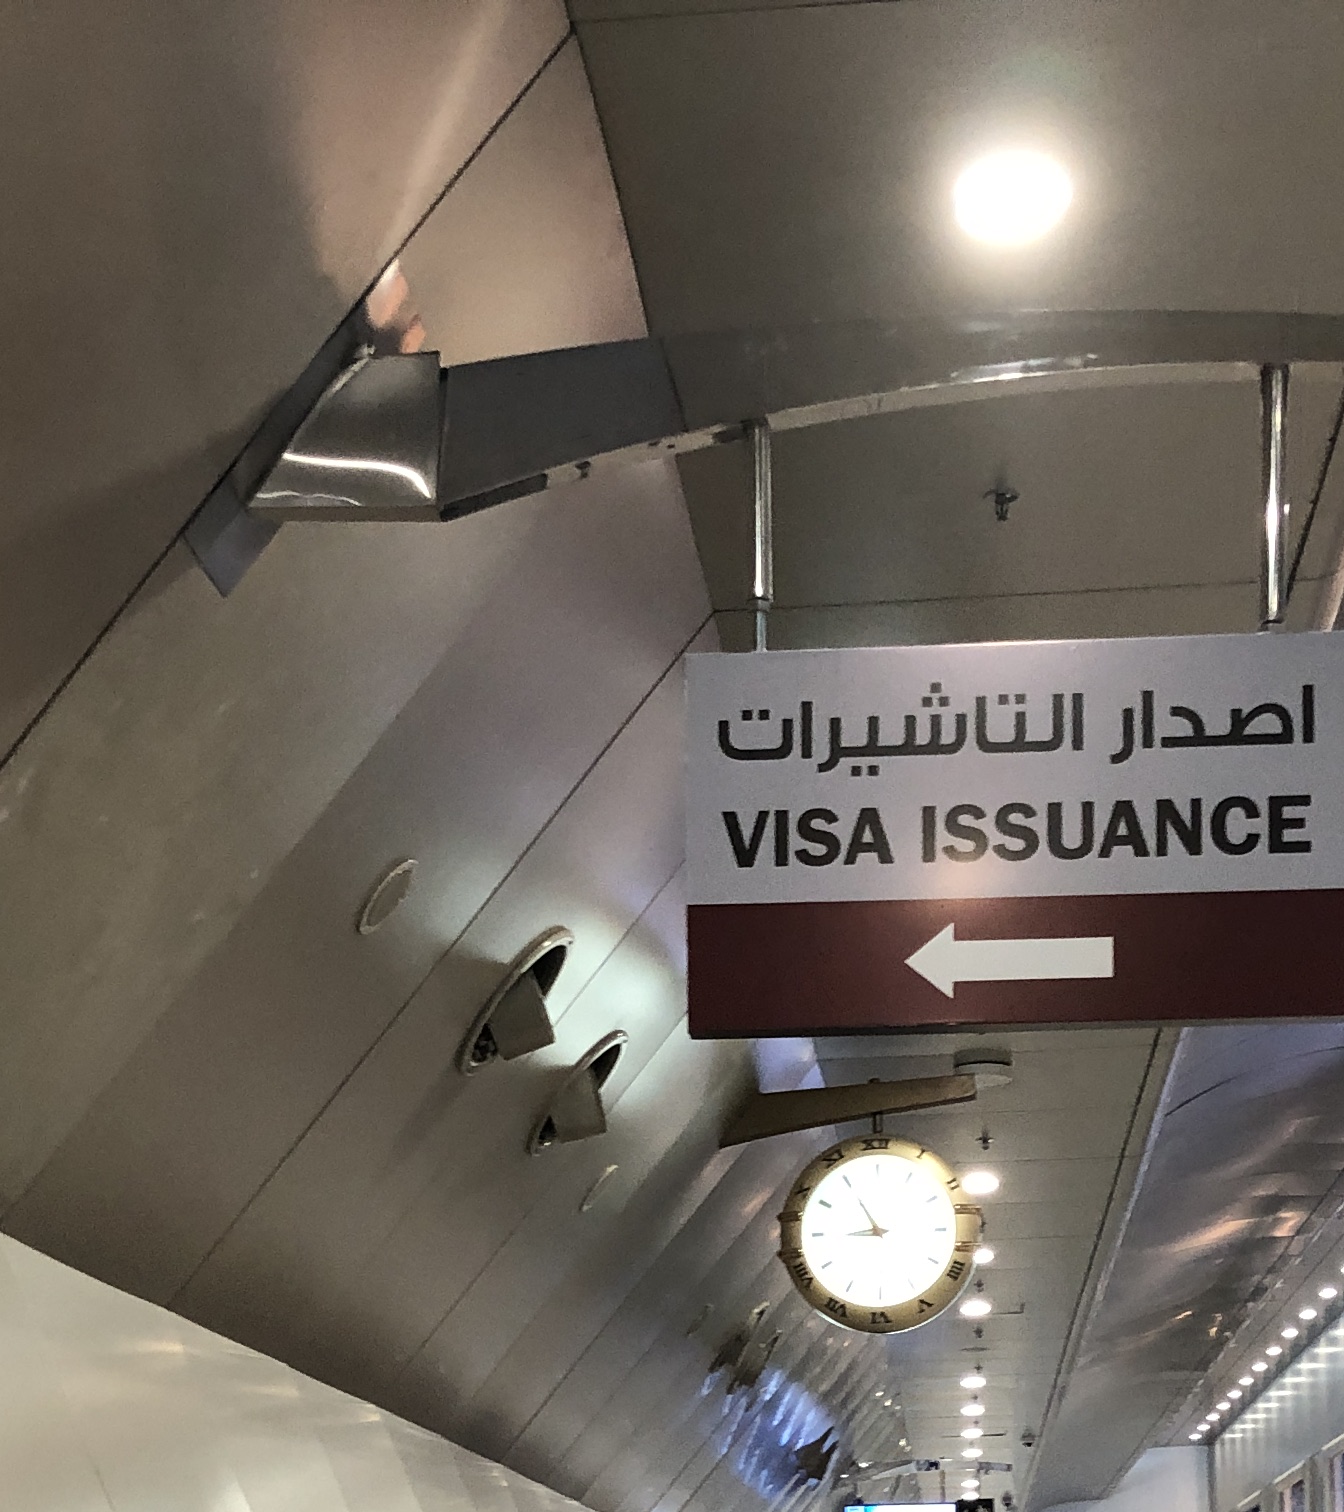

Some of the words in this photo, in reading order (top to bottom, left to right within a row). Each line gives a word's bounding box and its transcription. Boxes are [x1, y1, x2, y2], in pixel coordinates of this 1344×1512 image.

[717, 682, 1085, 777] التاشيرات
[1110, 684, 1315, 764] اصدار
[722, 806, 894, 868] VISA
[921, 794, 1312, 863] ISSUANCE
